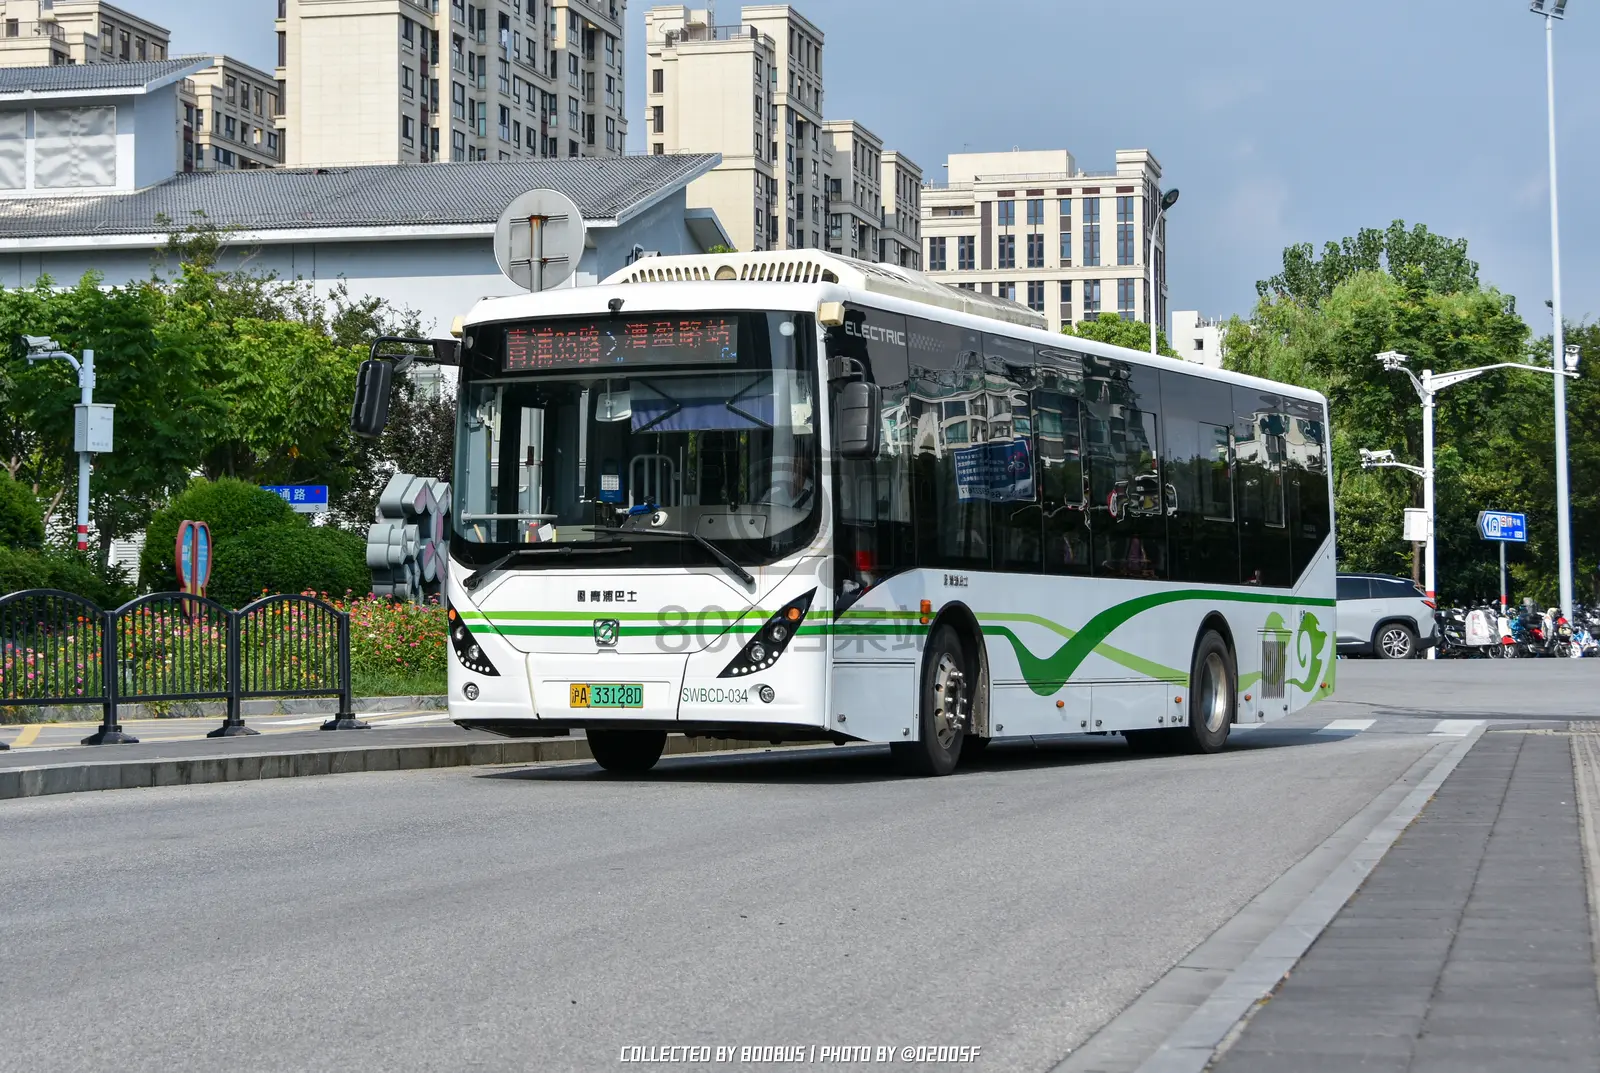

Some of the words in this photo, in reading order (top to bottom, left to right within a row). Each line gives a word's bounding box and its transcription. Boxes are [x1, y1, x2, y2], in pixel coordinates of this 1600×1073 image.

[845, 320, 906, 346] ELECTRIC
[594, 687, 642, 704] 33128D
[682, 687, 749, 703] SWBCD-034
